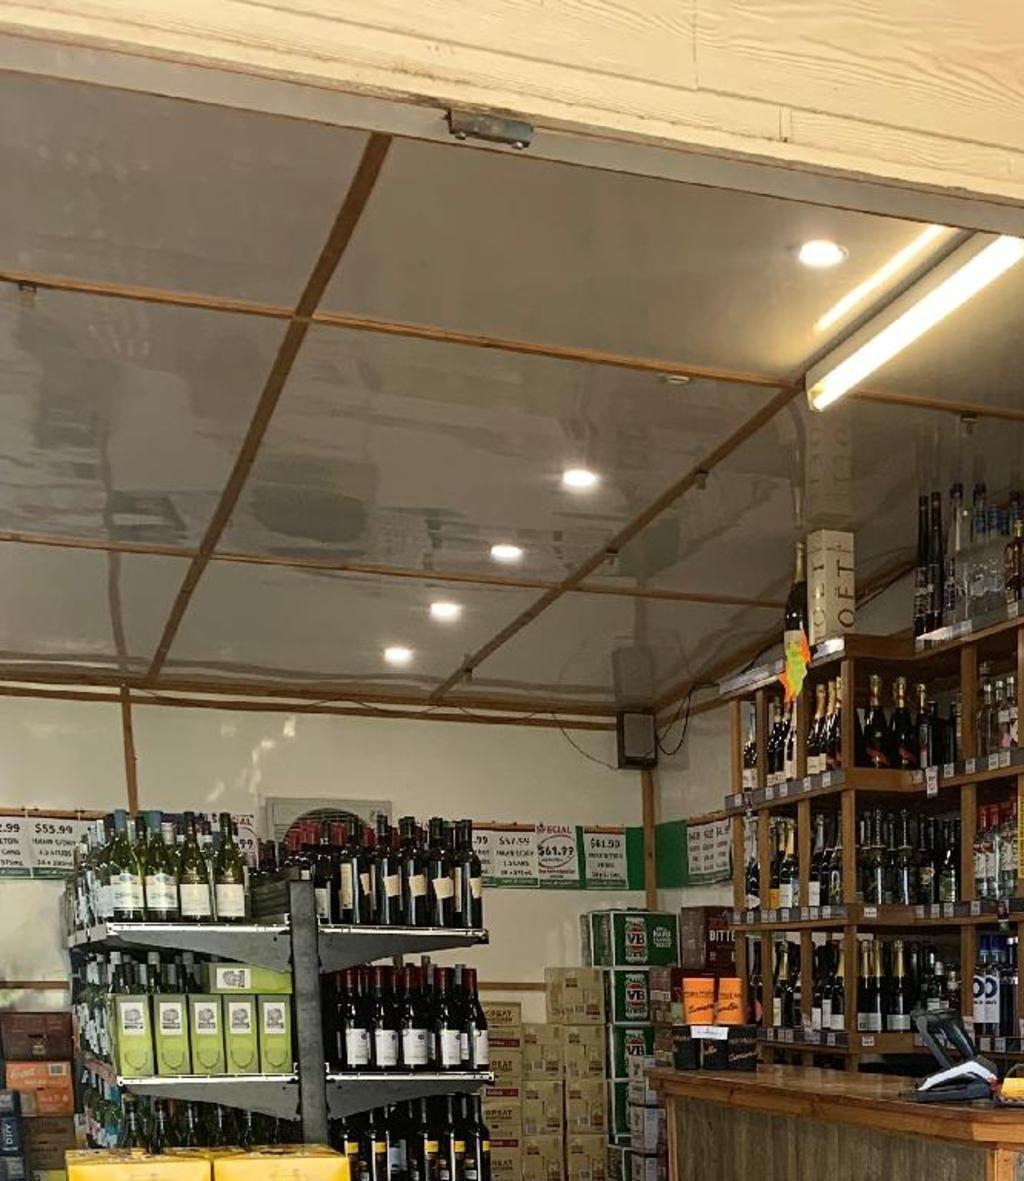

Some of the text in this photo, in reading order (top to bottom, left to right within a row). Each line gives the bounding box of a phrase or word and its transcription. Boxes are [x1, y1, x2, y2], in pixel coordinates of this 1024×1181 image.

[535, 824, 572, 834] SPECIAL
[627, 932, 645, 944] VB
[709, 929, 736, 942] BITTE
[627, 989, 645, 1001] VB
